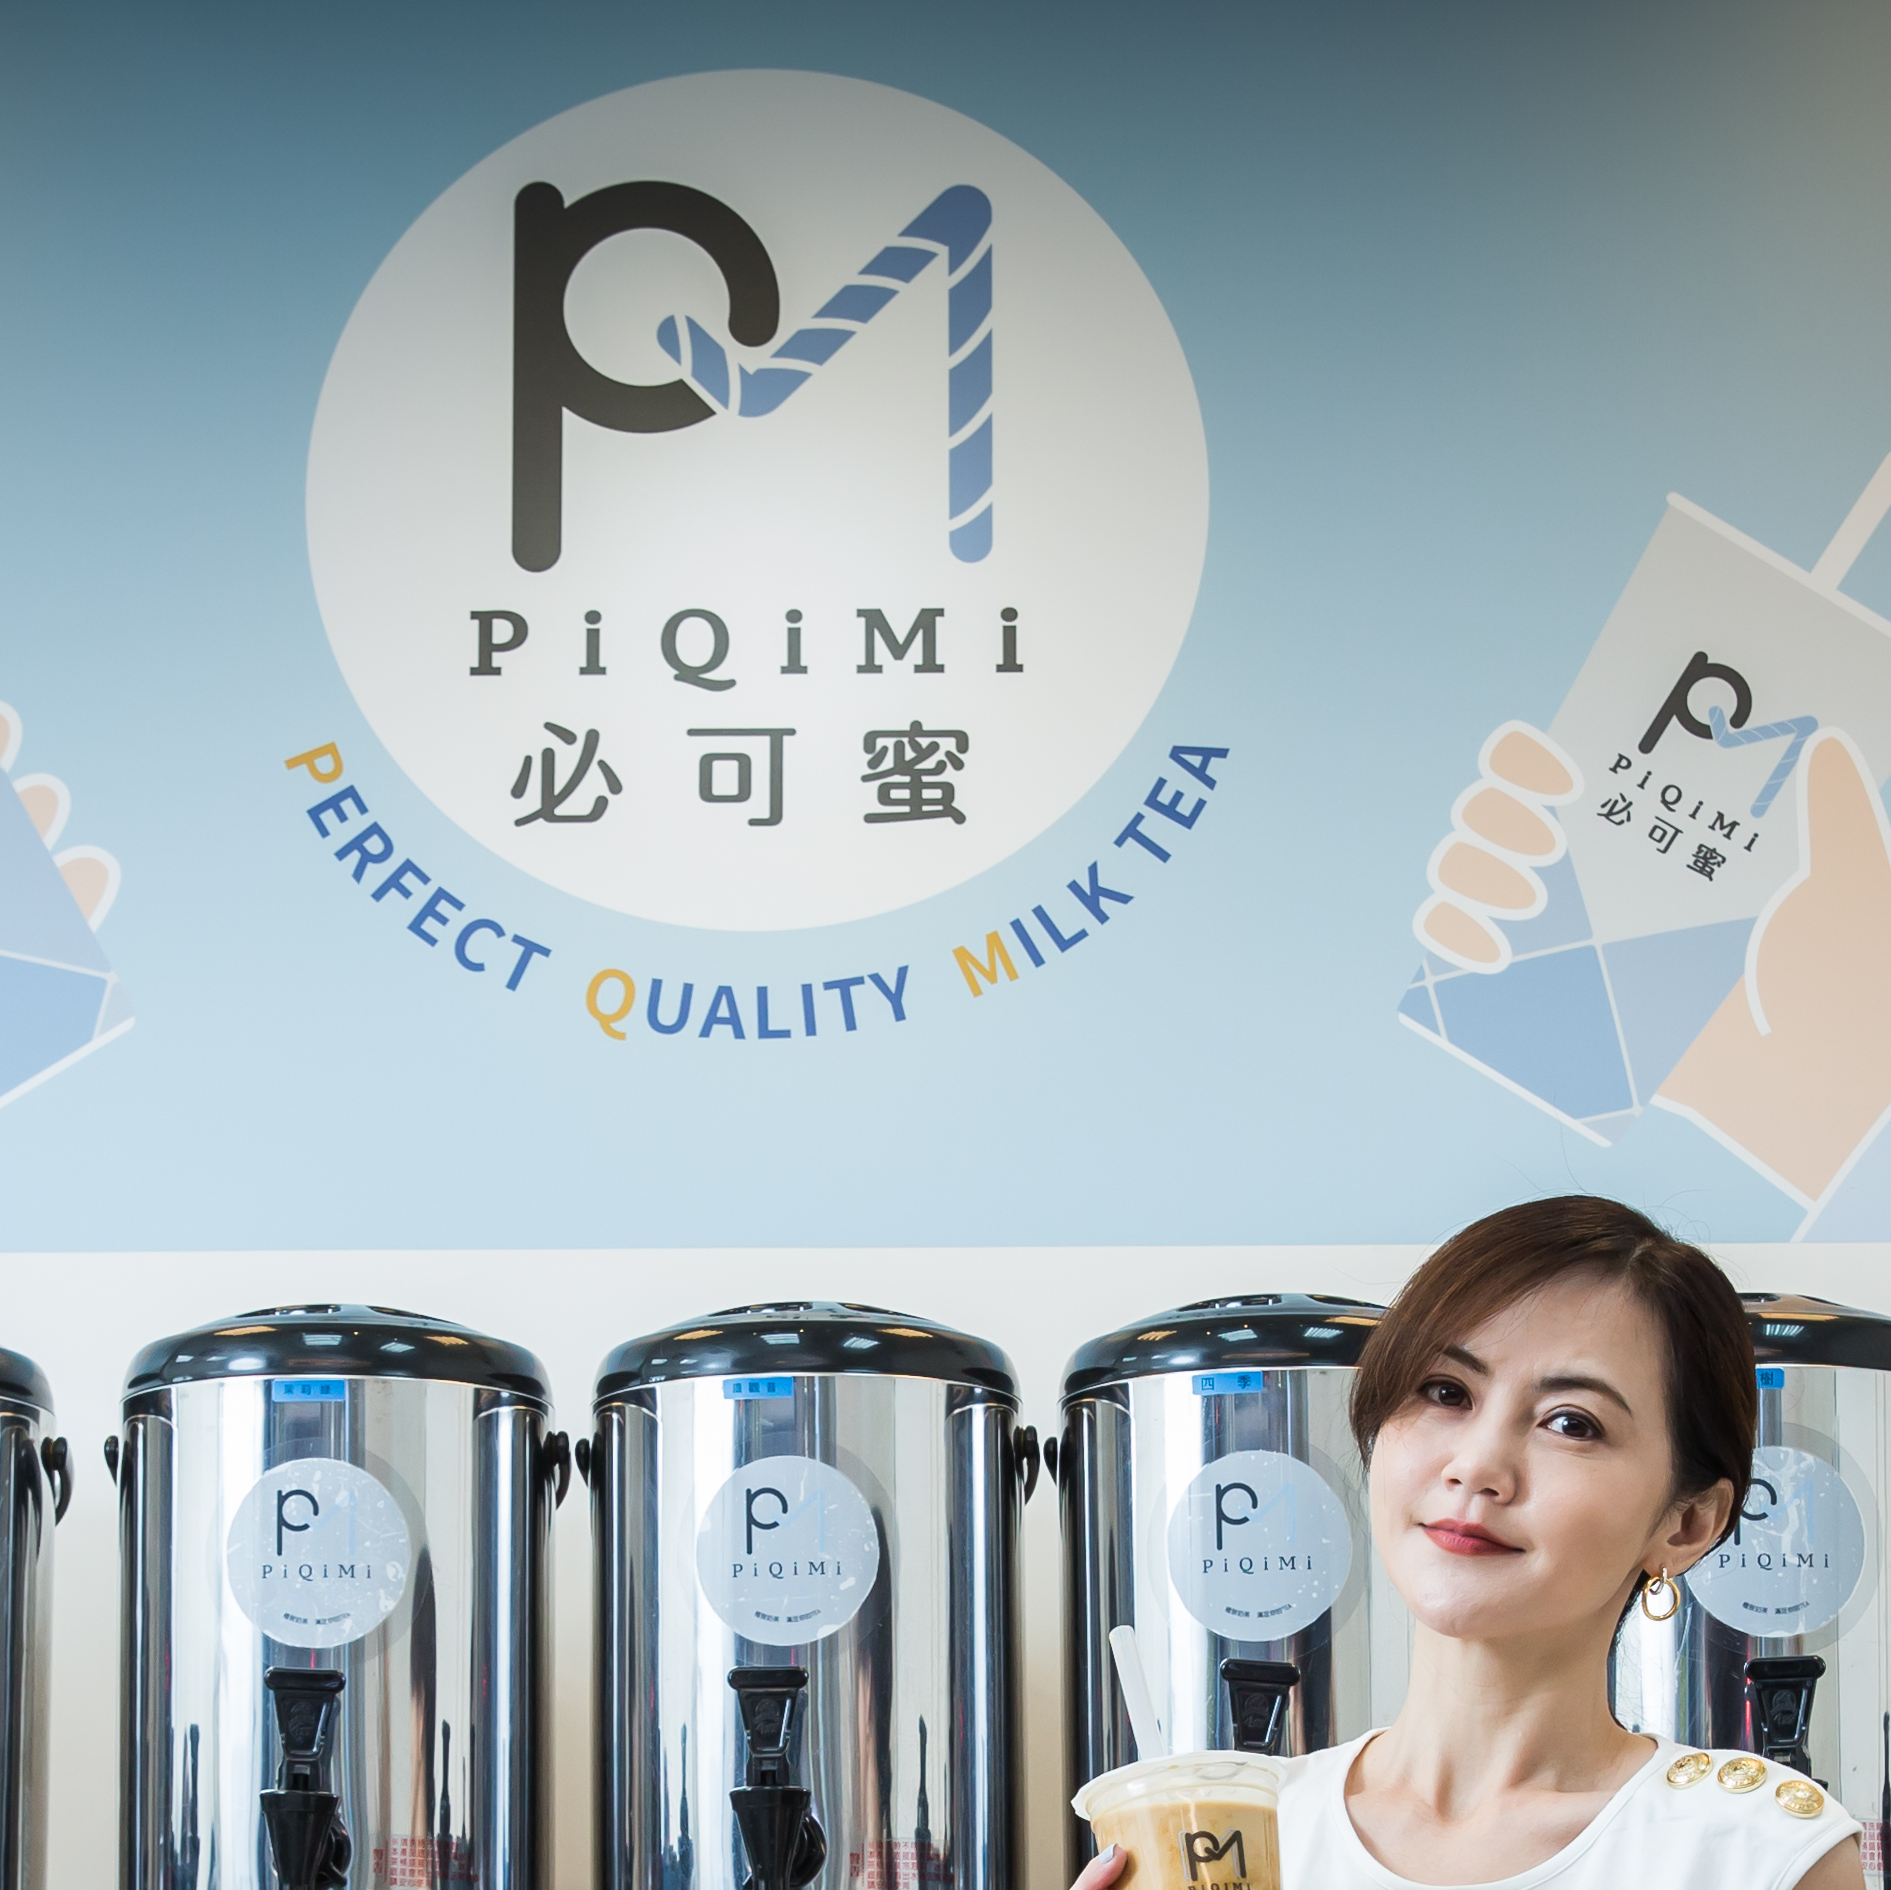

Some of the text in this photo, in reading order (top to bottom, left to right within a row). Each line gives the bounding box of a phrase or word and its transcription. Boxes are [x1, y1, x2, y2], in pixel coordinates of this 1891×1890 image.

[469, 607, 1024, 692] PiQiMi
[510, 720, 970, 826] 必可蜜
[1609, 753, 1759, 852] PiQiMi
[1597, 793, 1727, 881] 必可蜜
[284, 740, 1230, 1041] PERFECT QUALITY MILK TEA
[262, 1563, 372, 1582] PiQiMi
[732, 1561, 842, 1580] PiQiMi
[1202, 1556, 1313, 1575] PiQiMi
[1718, 1553, 1829, 1572] PiQiMi
